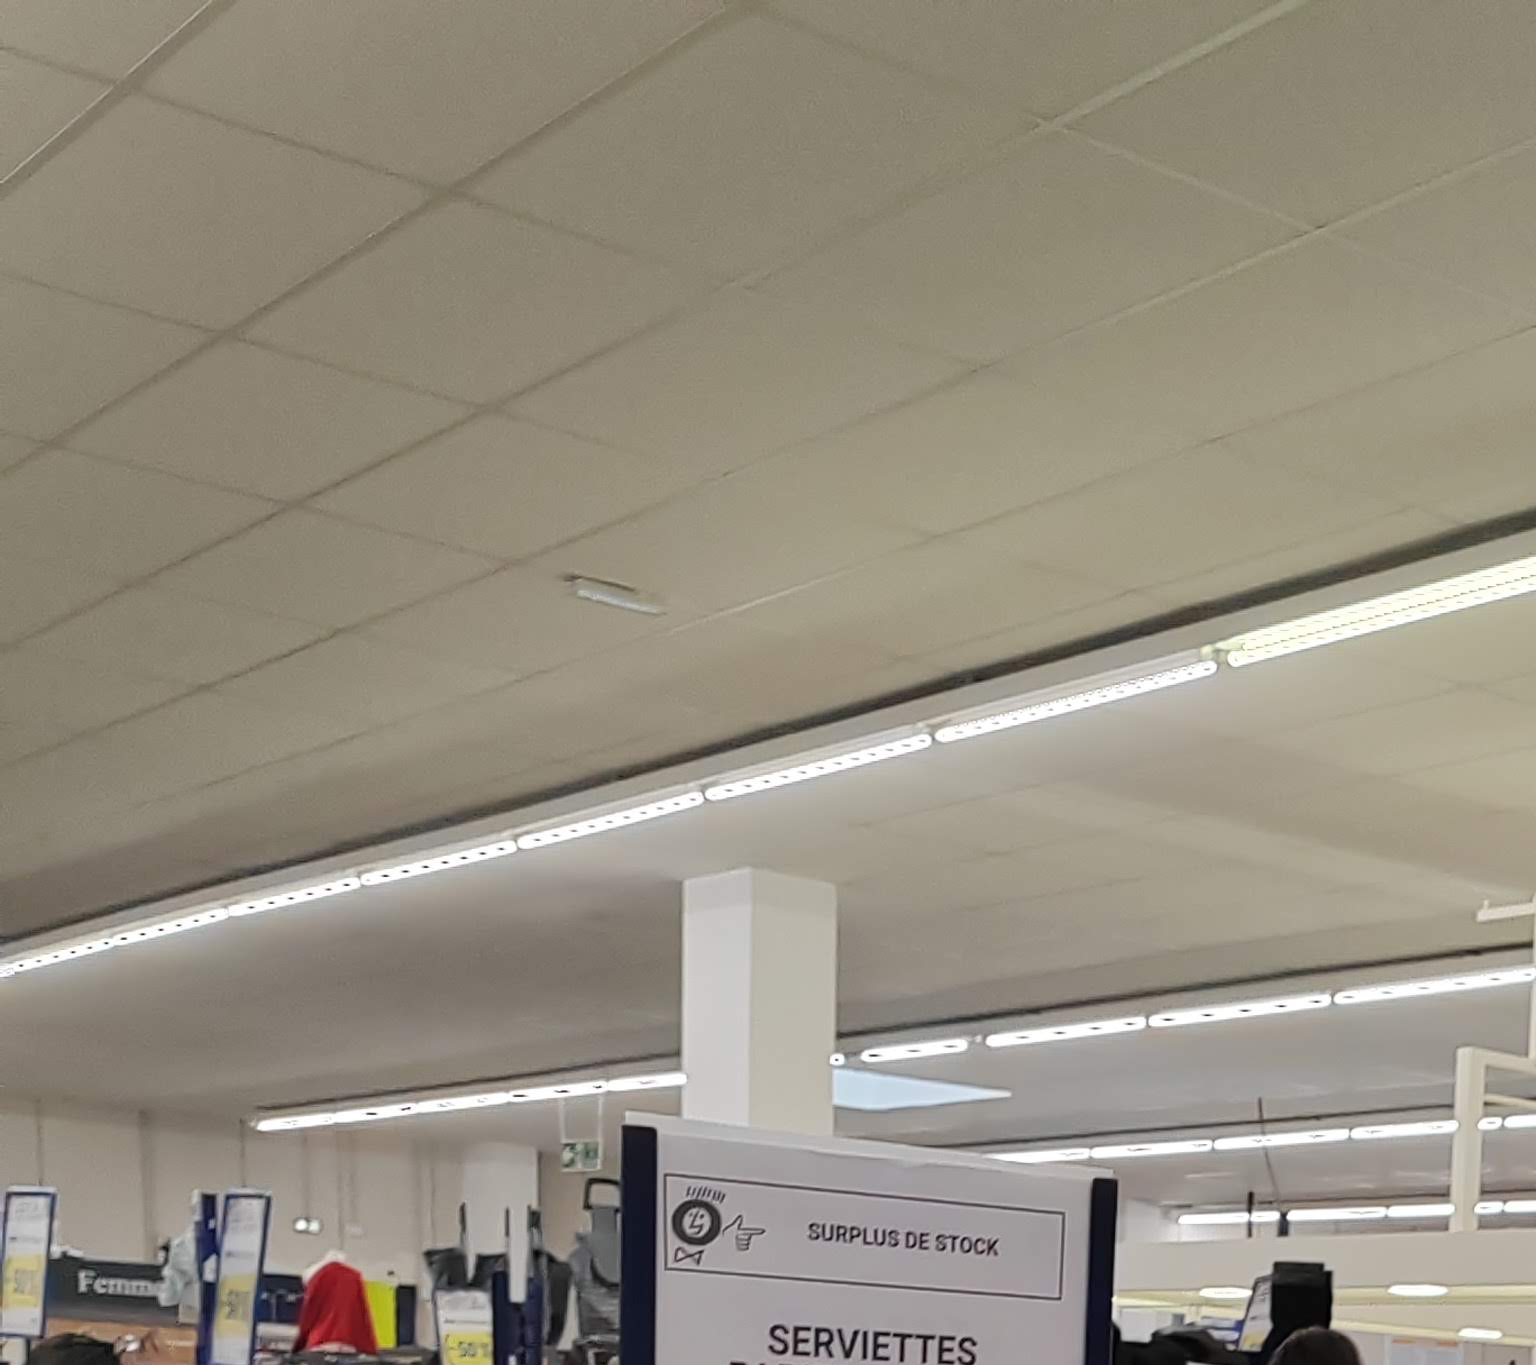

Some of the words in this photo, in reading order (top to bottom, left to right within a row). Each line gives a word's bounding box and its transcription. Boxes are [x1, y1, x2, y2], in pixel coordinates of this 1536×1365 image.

[808, 1221, 900, 1250] SURPLUS
[904, 1229, 932, 1252] DE
[934, 1230, 1000, 1258] STOCK
